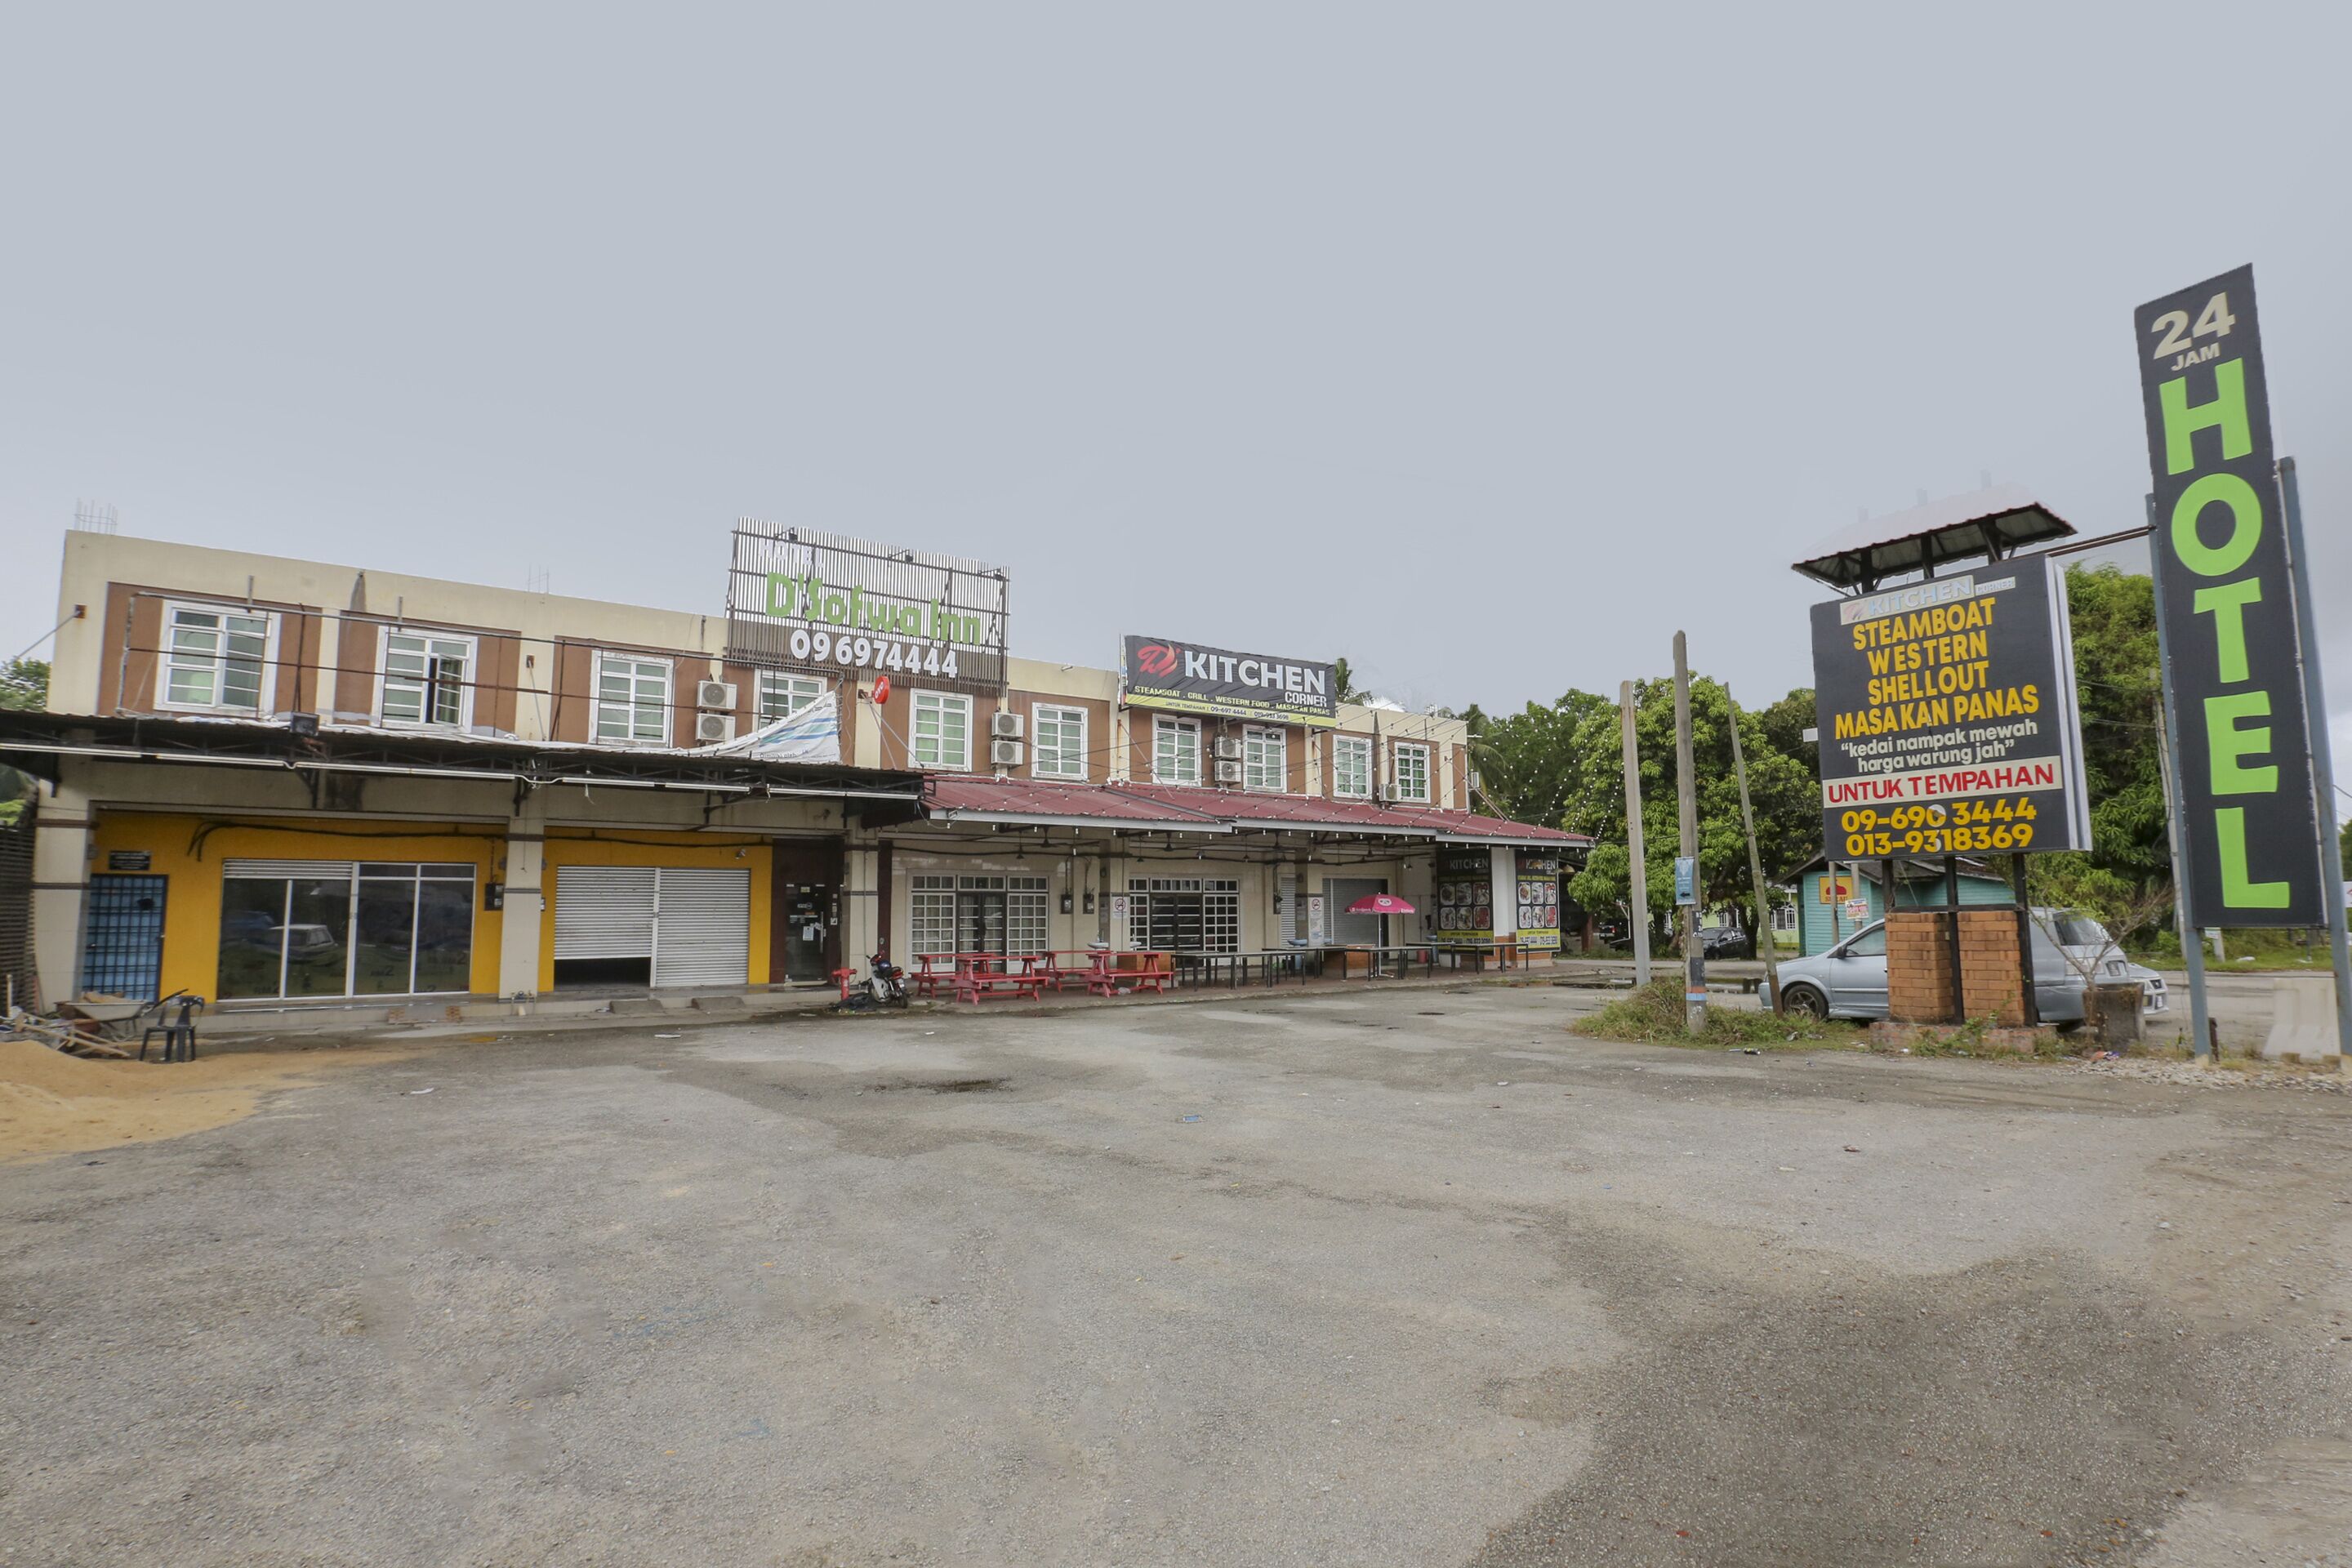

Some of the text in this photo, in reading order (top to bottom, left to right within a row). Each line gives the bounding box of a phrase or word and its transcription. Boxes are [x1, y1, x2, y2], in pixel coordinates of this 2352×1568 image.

[2151, 292, 2235, 359] 24
[2171, 342, 2221, 372] JAM
[1868, 577, 1972, 617] KITCHEN
[1976, 580, 2014, 594] CORNER
[930, 598, 981, 646] Inn
[1853, 597, 1996, 651] STEAMBOAT
[2159, 357, 2290, 909] HOTEL
[1184, 650, 1325, 694] KITCHEN
[1867, 630, 1988, 676] WESTERN
[1187, 693, 1209, 701] GRILL
[1215, 696, 1250, 706] WESTERN
[1251, 700, 1270, 709] FOOD
[1285, 692, 1327, 707] CORNER
[1835, 684, 2040, 740] MASAKAN PANAS
[1896, 727, 1966, 755] nampak
[1969, 719, 2038, 743] mewah
[1858, 751, 1904, 774] harga
[1907, 746, 1972, 765] warung
[1828, 763, 2055, 804] UNTUK TEMPAHAN
[1952, 797, 2037, 827] 3444
[1450, 858, 1489, 870] KITCHEN
